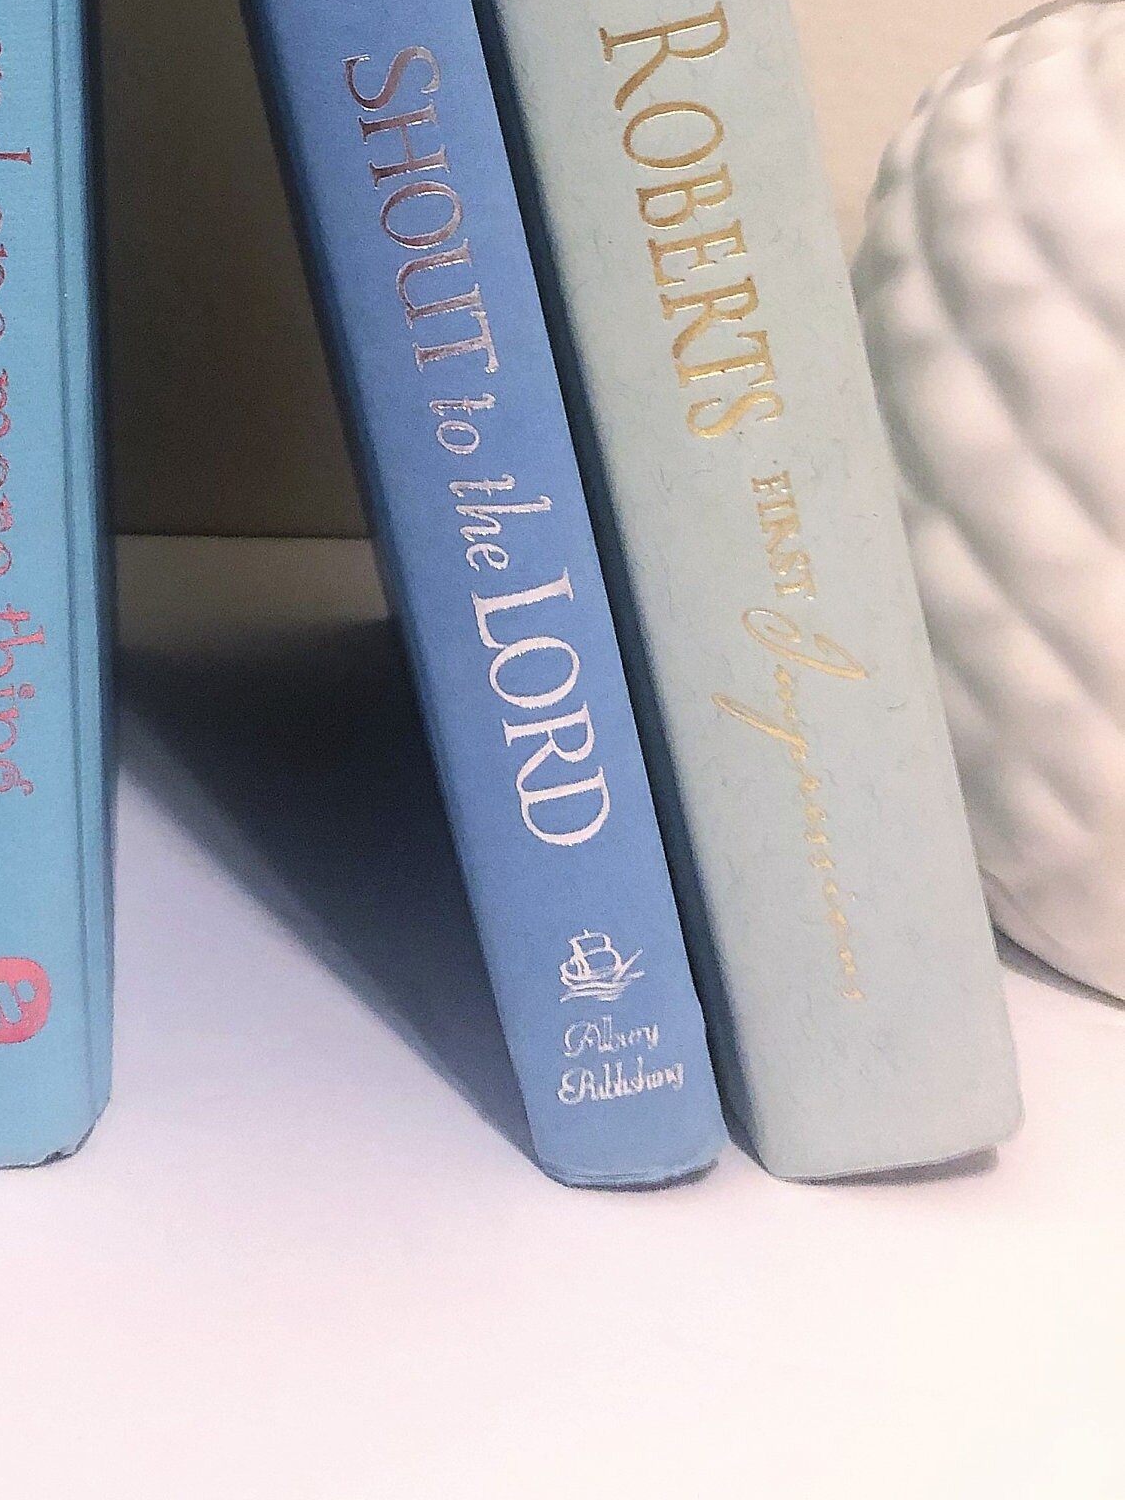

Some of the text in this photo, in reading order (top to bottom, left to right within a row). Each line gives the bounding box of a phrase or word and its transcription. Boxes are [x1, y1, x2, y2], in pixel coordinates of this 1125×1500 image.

[341, 45, 612, 848] SHOUT to the LORD
[598, 0, 785, 439] ROBERTS
[750, 469, 818, 602] FIRST
